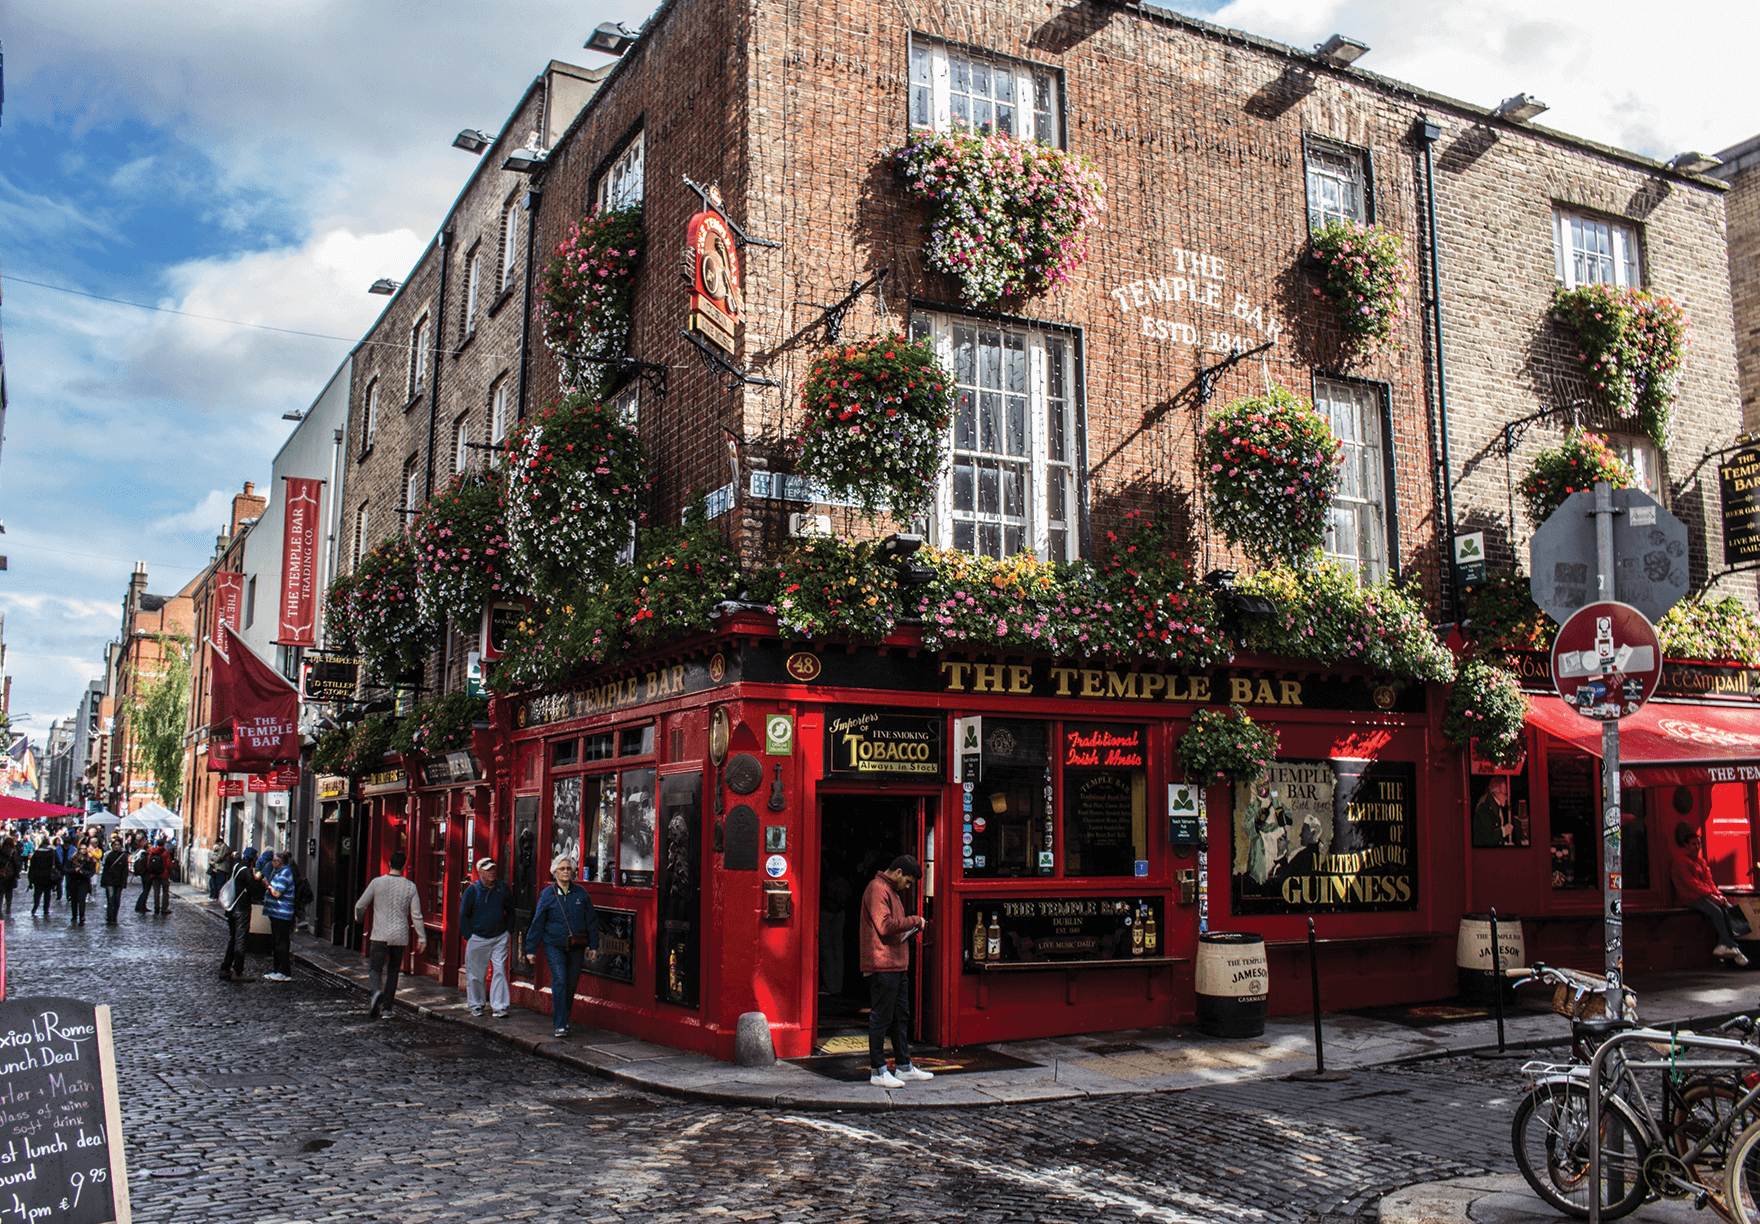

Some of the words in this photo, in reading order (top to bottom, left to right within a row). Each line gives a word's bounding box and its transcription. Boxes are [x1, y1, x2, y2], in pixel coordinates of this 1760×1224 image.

[1173, 247, 1225, 281] THE
[1111, 277, 1222, 313] TEMPLE
[1233, 292, 1284, 344] BAR
[1209, 331, 1255, 352] 1840
[1737, 453, 1755, 464] THE
[1734, 476, 1760, 492] BAR
[292, 508, 304, 535] BAR
[1725, 508, 1744, 518] BEER
[304, 527, 314, 546] CO.
[1728, 537, 1747, 547] LIVE
[289, 537, 302, 589] TEMPLE
[302, 548, 312, 600] TRADING
[228, 593, 236, 613] THE
[287, 595, 299, 618] THE
[217, 606, 226, 644] TRDING
[712, 659, 722, 677] 48
[793, 656, 814, 674] 48
[314, 681, 358, 689] DSTILLER
[574, 677, 638, 714] TEMPLE
[645, 665, 685, 699] BAR
[942, 661, 1034, 693] THE
[1051, 667, 1212, 701] TEMPLE
[1228, 677, 1303, 706] BAR
[237, 723, 293, 737] TEMPLE
[254, 717, 277, 726] THE
[829, 712, 879, 734] Importers
[252, 736, 281, 747] BAR
[873, 730, 891, 739] FINE
[892, 731, 929, 740] SMOKING
[1068, 730, 1139, 747] Traditional
[860, 761, 894, 771] Always
[910, 763, 937, 772] Stock
[1066, 748, 1099, 765] Irish
[1104, 749, 1142, 766] Music
[1267, 768, 1332, 783] TEMPLE
[1708, 767, 1736, 781] THE
[1080, 776, 1113, 793] TEMPLE
[1115, 779, 1131, 795] BAR
[1287, 784, 1318, 800] BAR
[1378, 782, 1403, 800] THE
[1347, 801, 1403, 822] EMPEROR
[1390, 824, 1404, 843] OF
[1312, 852, 1360, 874] MALTED
[1361, 845, 1409, 869] LIQUORS
[1282, 875, 1411, 904] GUINNESS
[1003, 902, 1035, 917] THE
[1038, 901, 1097, 917] TEMPLE
[1101, 901, 1130, 916] BAR
[1053, 917, 1083, 927] DUBLIN
[1038, 941, 1054, 951] LIVE
[1055, 941, 1075, 949] MUSIC
[1077, 940, 1097, 949] DAILY
[1479, 946, 1520, 958] JAESON
[32, 1019, 45, 1042] to
[40, 1011, 95, 1042] Rome
[40, 1042, 79, 1067] Deal
[49, 1072, 95, 1098] Main
[37, 1103, 52, 1119] of
[61, 1100, 90, 1112] wine
[12, 1119, 43, 1136] soft
[53, 1115, 84, 1129] drink
[24, 1132, 68, 1159] lunch
[76, 1123, 107, 1148] deal
